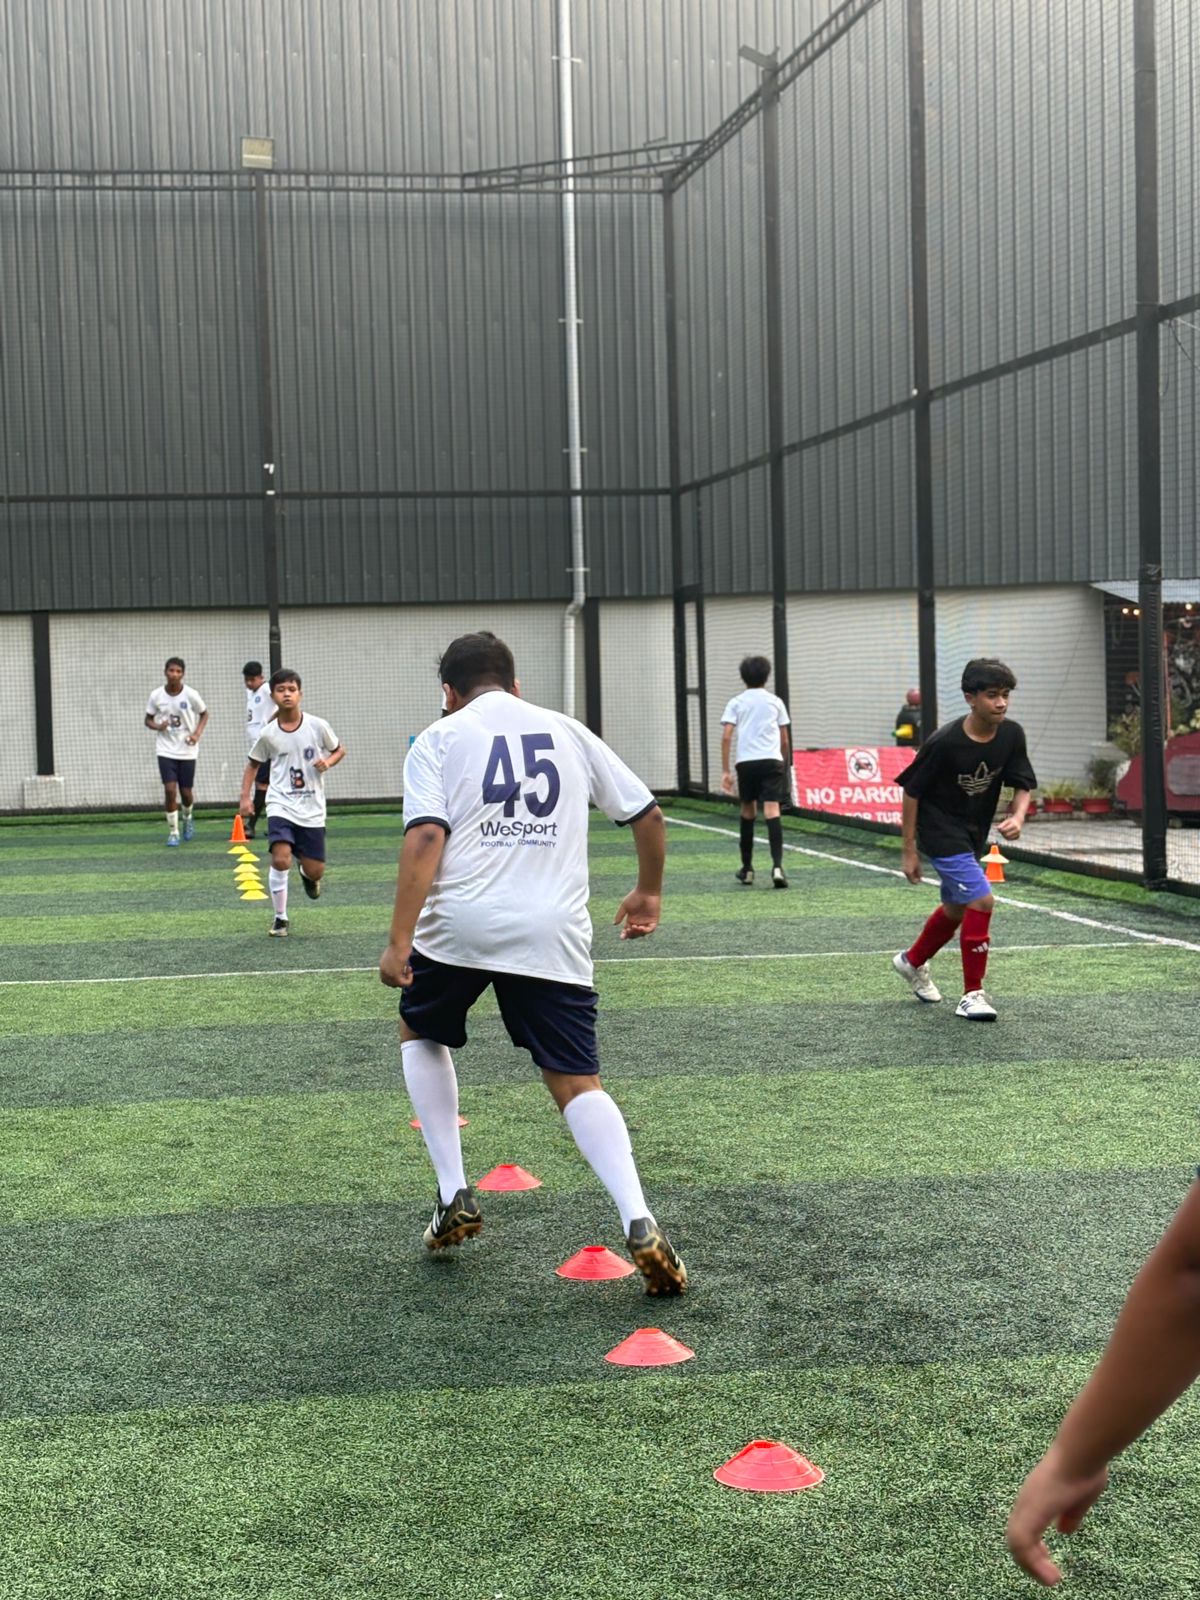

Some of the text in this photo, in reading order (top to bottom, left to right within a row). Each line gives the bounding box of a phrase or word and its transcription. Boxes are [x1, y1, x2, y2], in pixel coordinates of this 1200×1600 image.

[482, 733, 560, 818] 45
[806, 786, 904, 805] NO PARKI
[875, 811, 903, 824] TUR
[480, 821, 557, 838] WeSport
[517, 839, 557, 848] COMMUNITY
